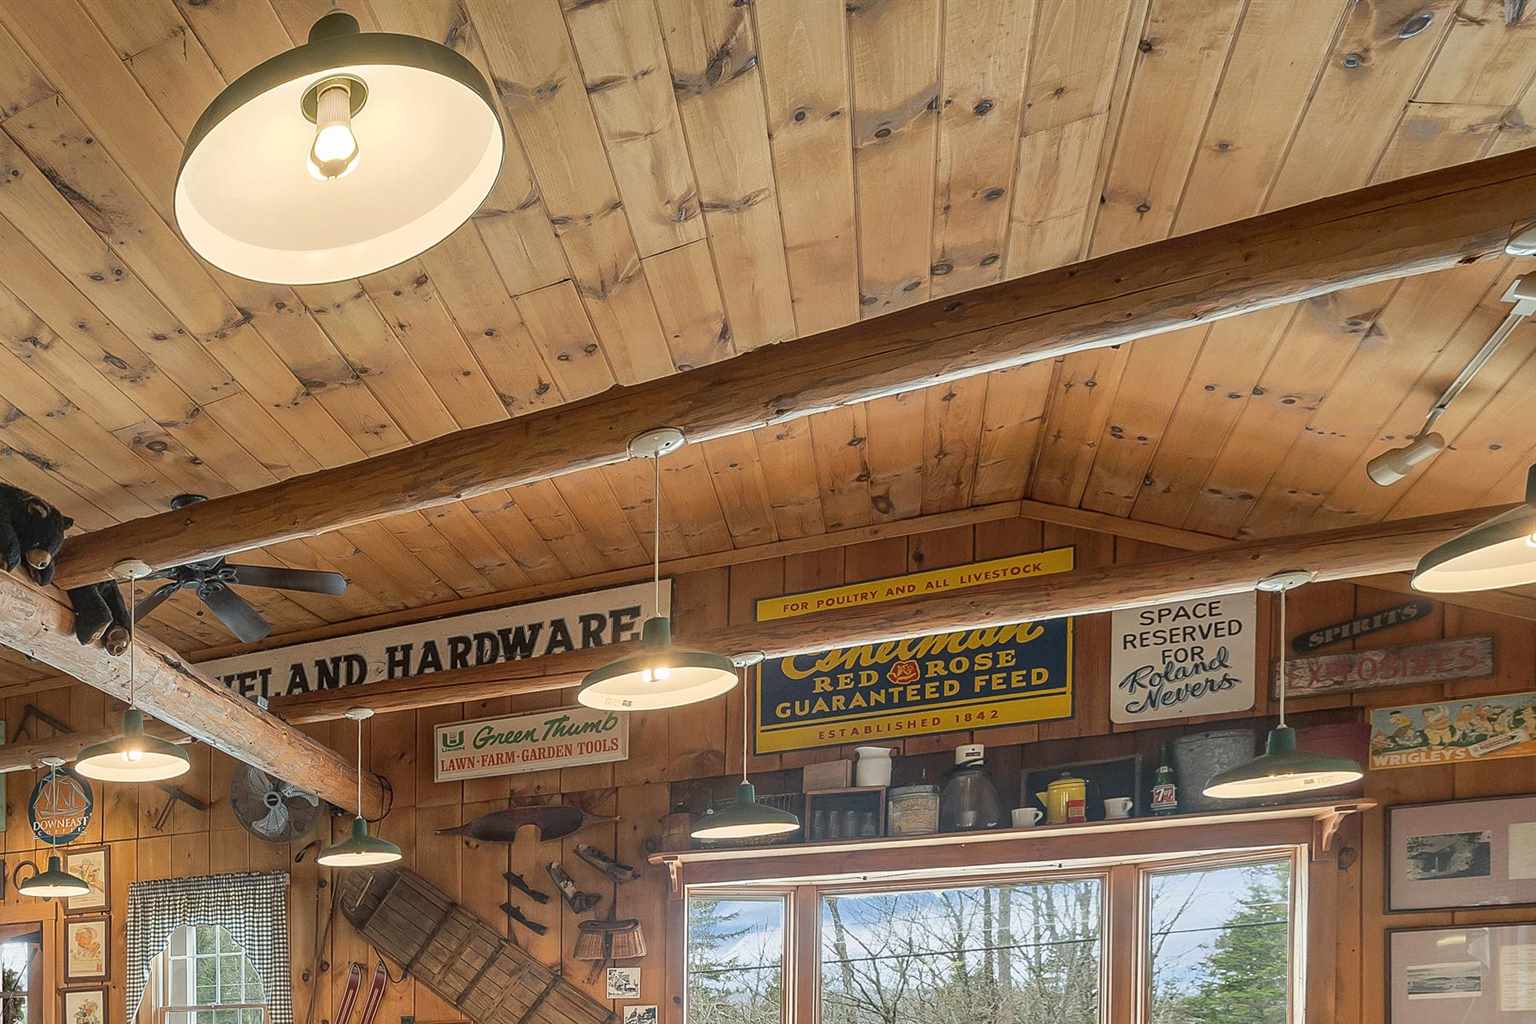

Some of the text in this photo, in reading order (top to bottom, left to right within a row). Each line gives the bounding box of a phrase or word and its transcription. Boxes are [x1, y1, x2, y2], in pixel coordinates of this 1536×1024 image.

[783, 562, 1042, 613] FOR POULTRY AND ALL LIVESTOCK
[1139, 600, 1222, 626] SPACE
[1308, 603, 1417, 649] SPIRITS
[384, 604, 642, 680] HARDWARE
[1123, 619, 1242, 650] RESERVED
[813, 649, 1017, 694] RED ROSE
[1118, 646, 1231, 694] Roland
[1162, 646, 1204, 664] FOR
[775, 667, 1049, 719] GUARANTEED FEED
[1125, 672, 1241, 714] Nevers
[473, 725, 539, 750] Green
[543, 711, 619, 741] Thumb
[818, 709, 1000, 740] ESTABLISHED 1842
[576, 737, 619, 755] TOOLS
[33, 816, 88, 831] DOWNEAST
